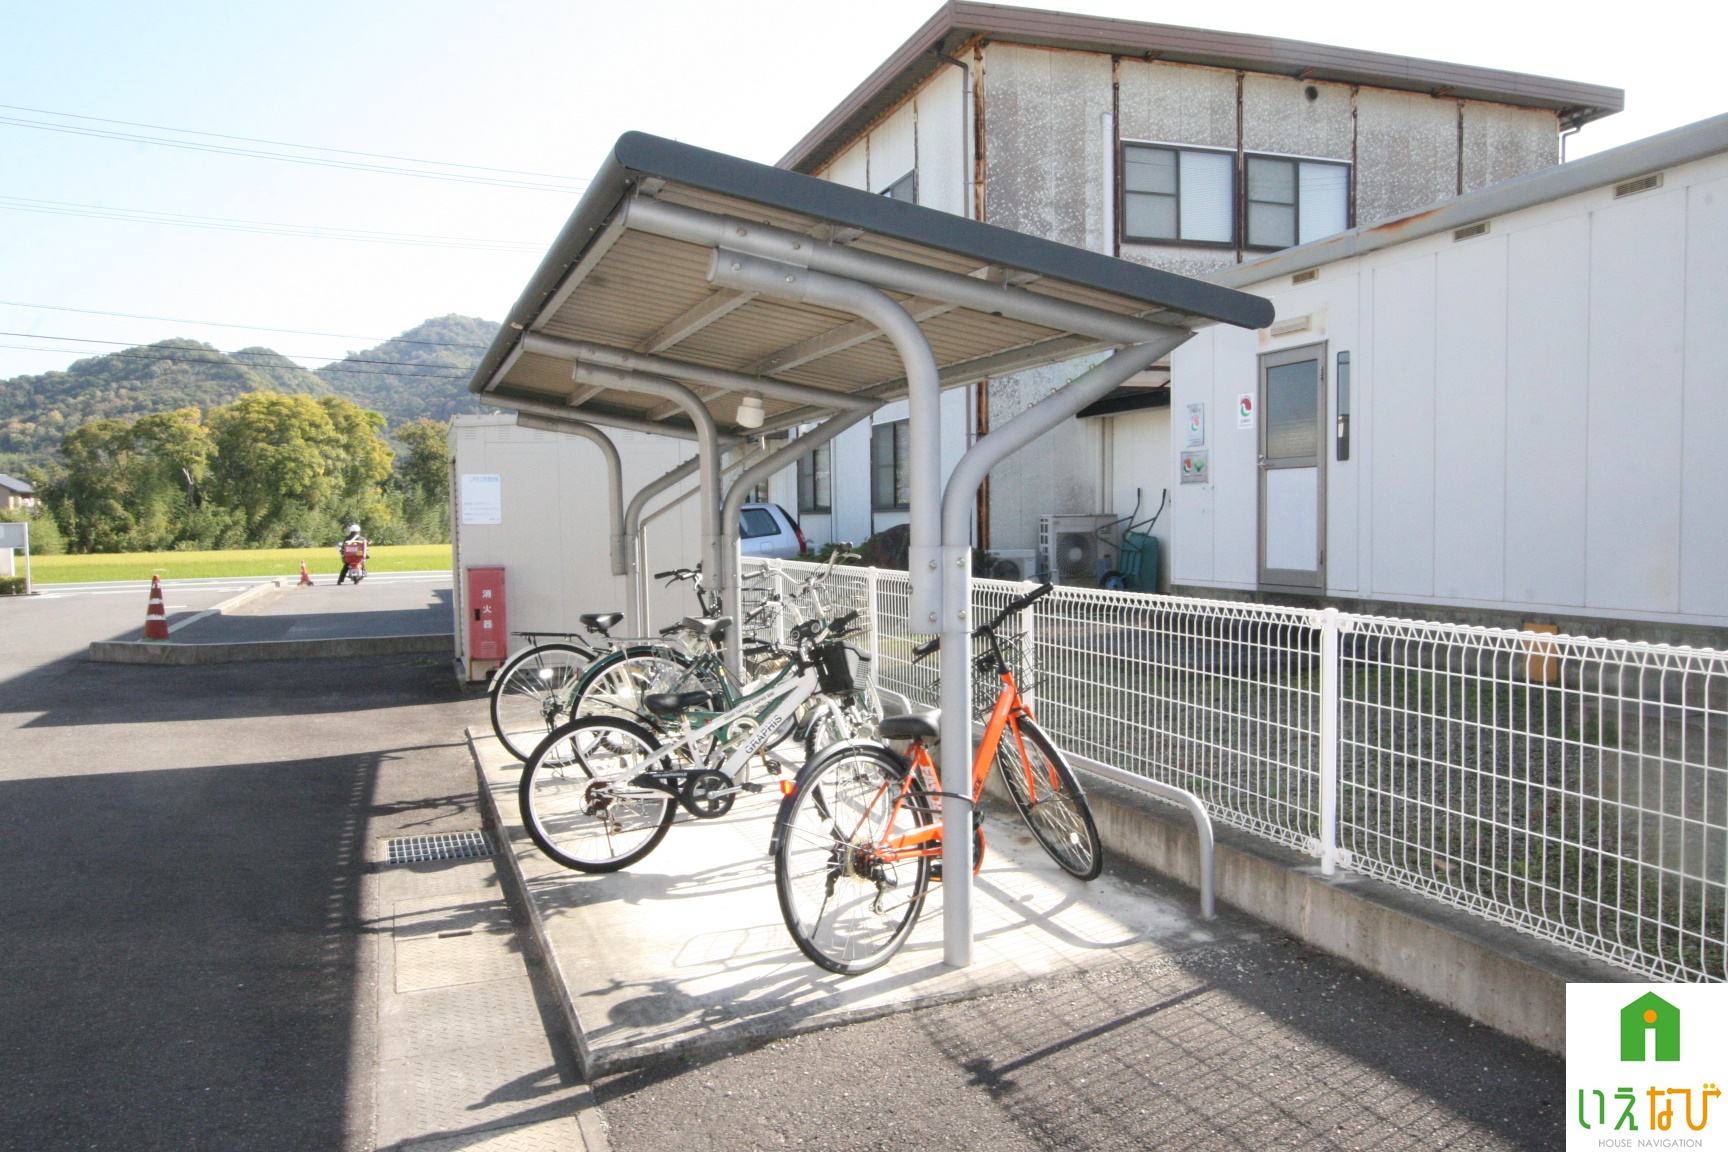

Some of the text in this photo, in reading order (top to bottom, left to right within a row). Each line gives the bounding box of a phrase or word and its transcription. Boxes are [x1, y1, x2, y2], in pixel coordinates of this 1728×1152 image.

[482, 589, 493, 629] 消火器
[736, 703, 751, 714] FACTORY
[745, 714, 782, 754] GRAPHIS
